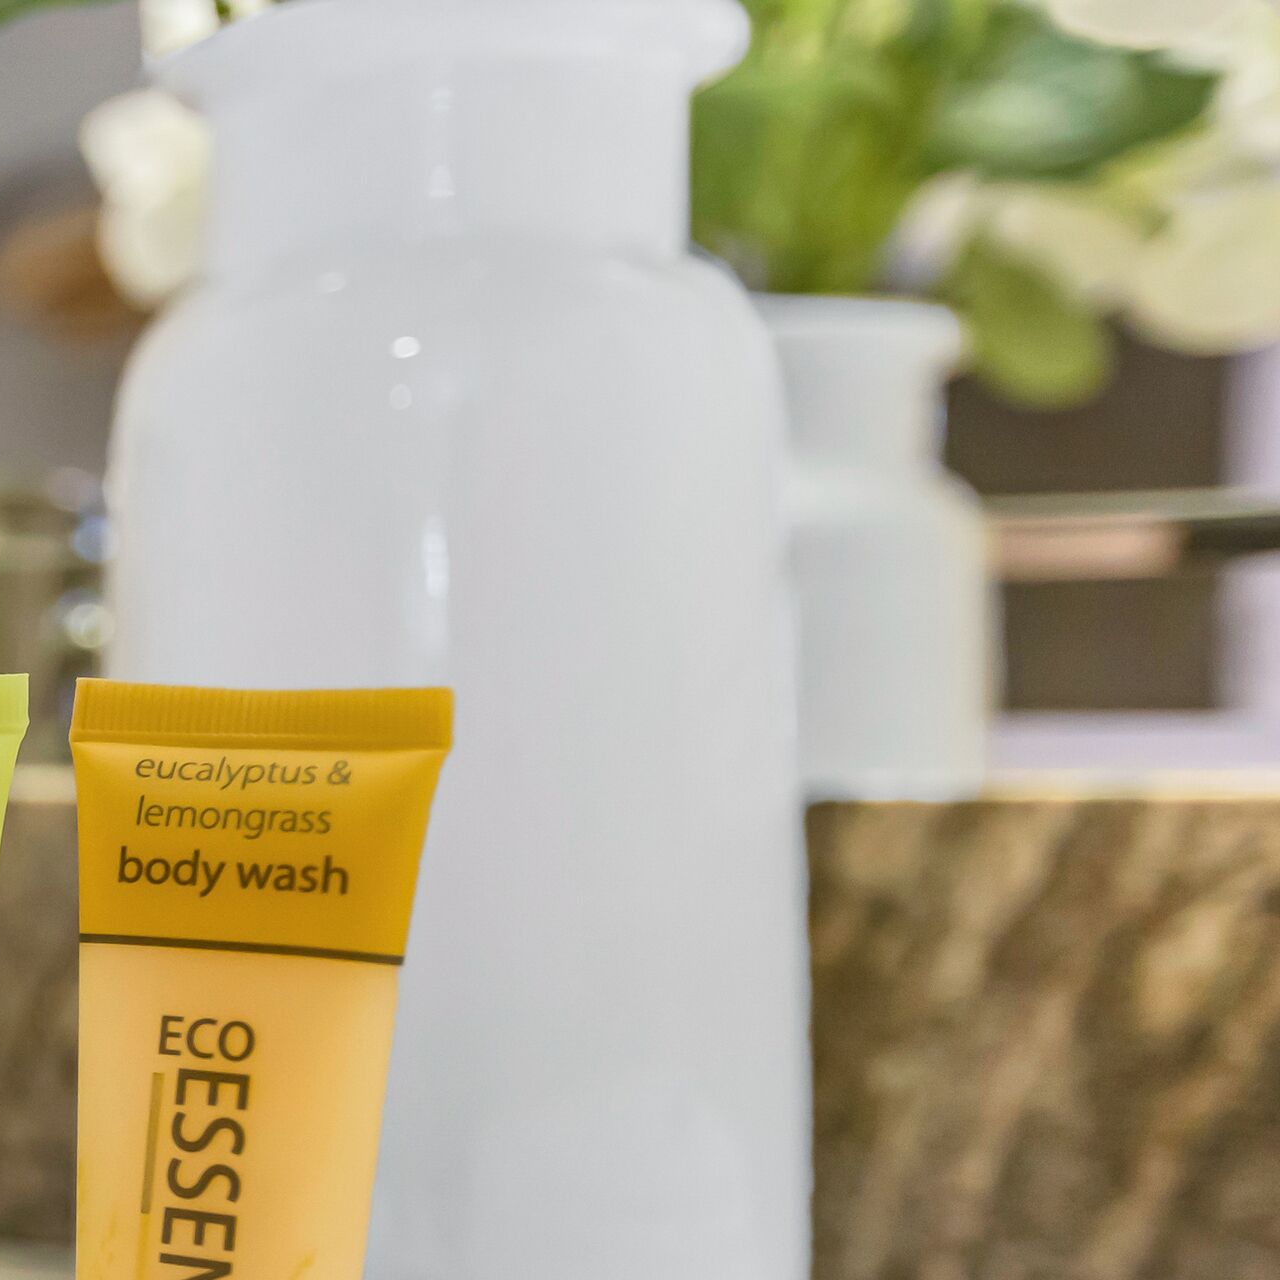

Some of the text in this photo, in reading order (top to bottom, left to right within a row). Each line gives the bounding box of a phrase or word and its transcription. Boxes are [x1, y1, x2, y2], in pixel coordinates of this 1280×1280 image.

[135, 756, 352, 790] eucalyptus &
[135, 795, 332, 840] lemongrass
[118, 845, 350, 898] body wash
[158, 1014, 257, 1062] ECO
